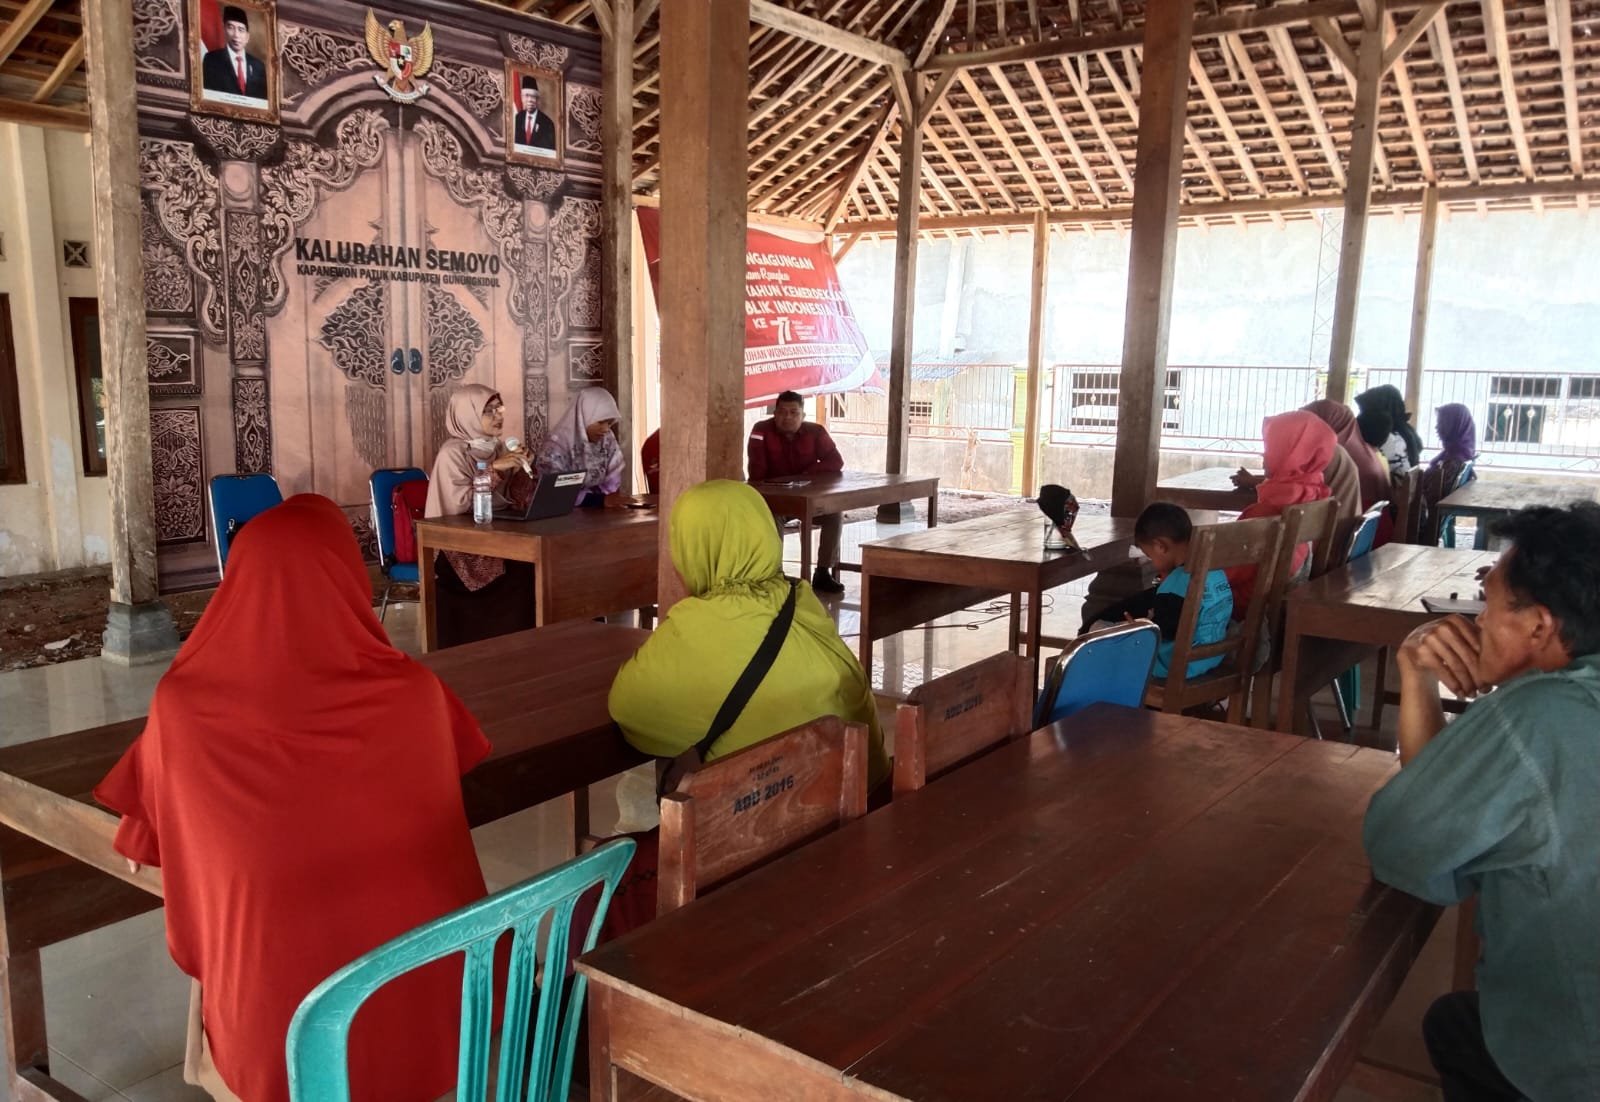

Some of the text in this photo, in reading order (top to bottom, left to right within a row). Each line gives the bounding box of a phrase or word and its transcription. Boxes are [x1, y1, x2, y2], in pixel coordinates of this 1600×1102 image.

[295, 238, 500, 274] KALURAHAN SEMOYO
[297, 264, 500, 287] KAPANEWON PATUK KABUPATEN GUNUNGKIDUL
[752, 318, 768, 328] KE
[764, 775, 794, 800] 2016
